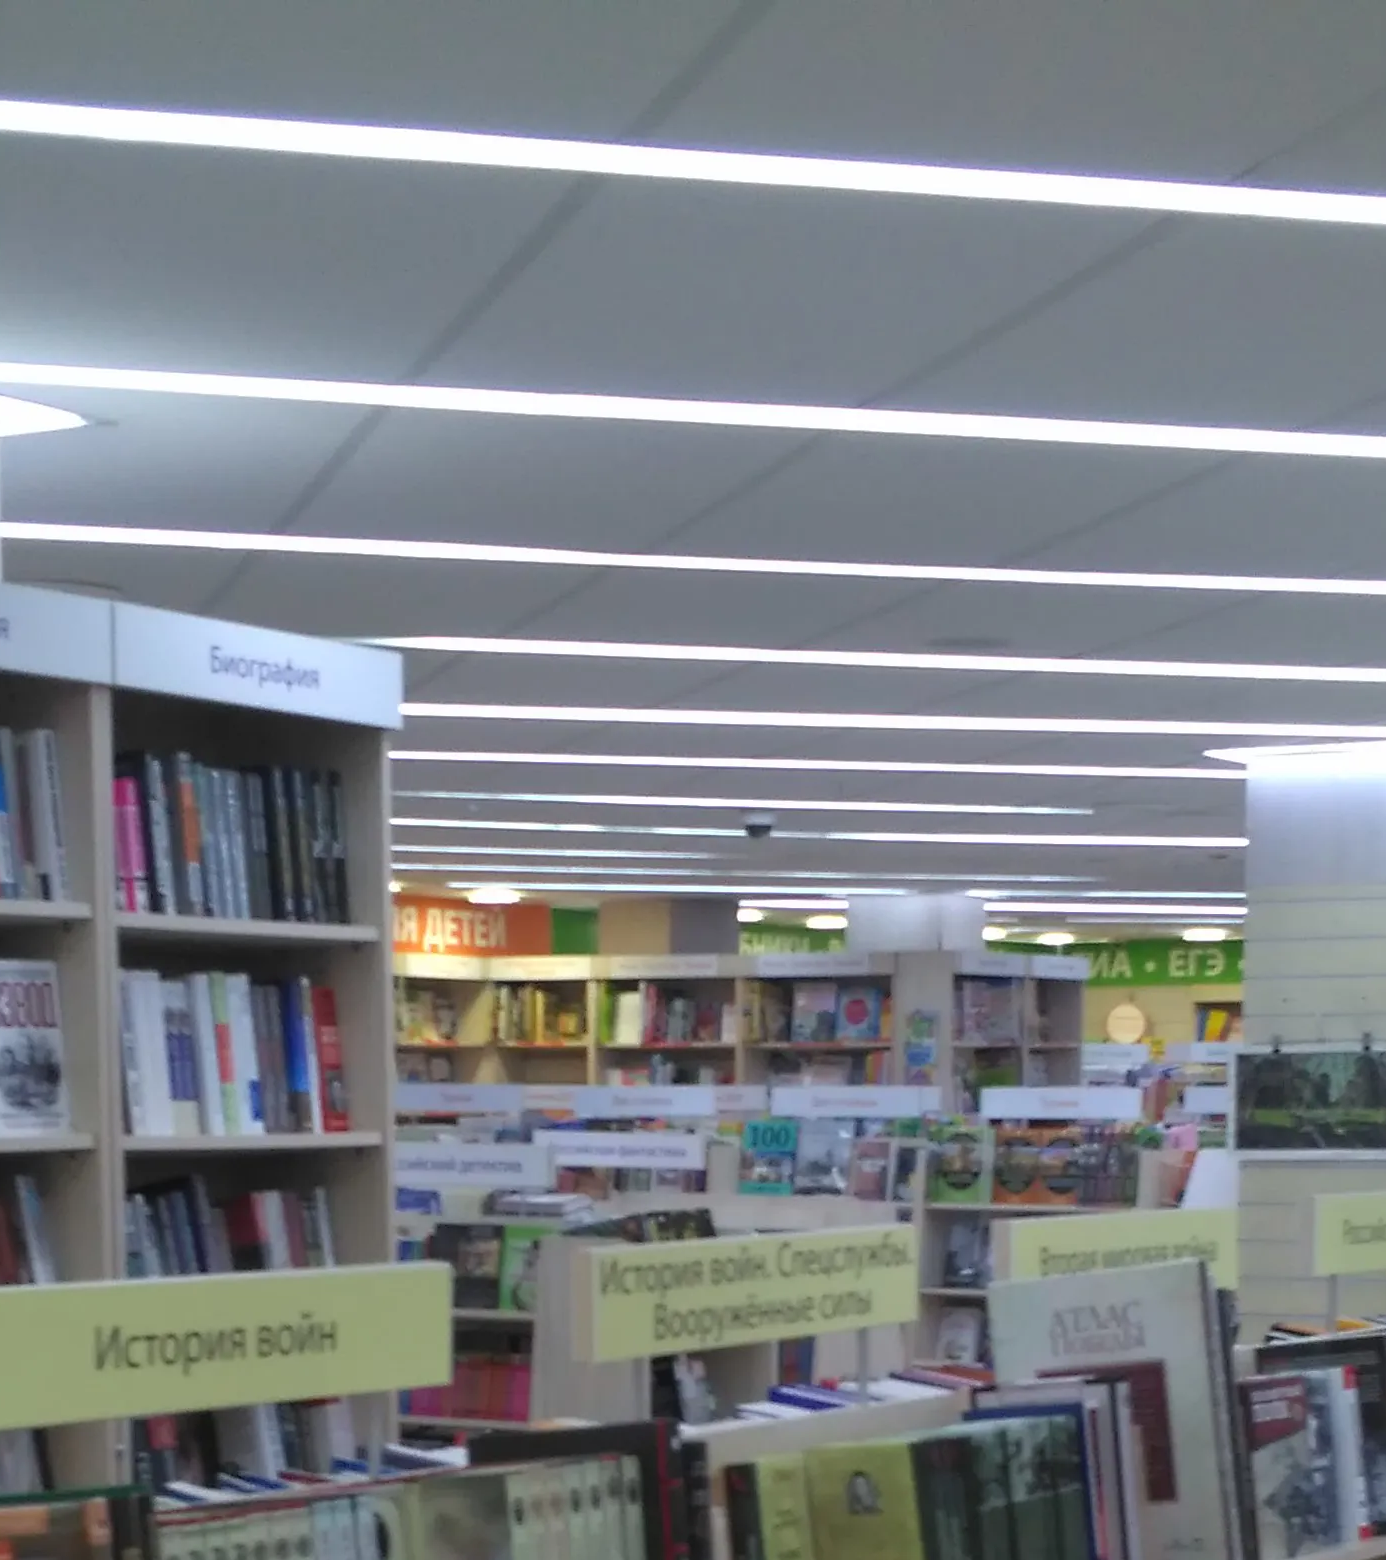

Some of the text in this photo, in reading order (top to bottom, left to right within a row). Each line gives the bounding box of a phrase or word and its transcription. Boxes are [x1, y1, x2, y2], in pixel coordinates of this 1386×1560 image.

[209, 644, 322, 690] Биография
[422, 906, 507, 953] ДЕТЕЙ
[1166, 947, 1227, 978] ЕГЭ
[747, 1124, 793, 1150] 100
[598, 1255, 702, 1296] История
[93, 1312, 338, 1376] История войн
